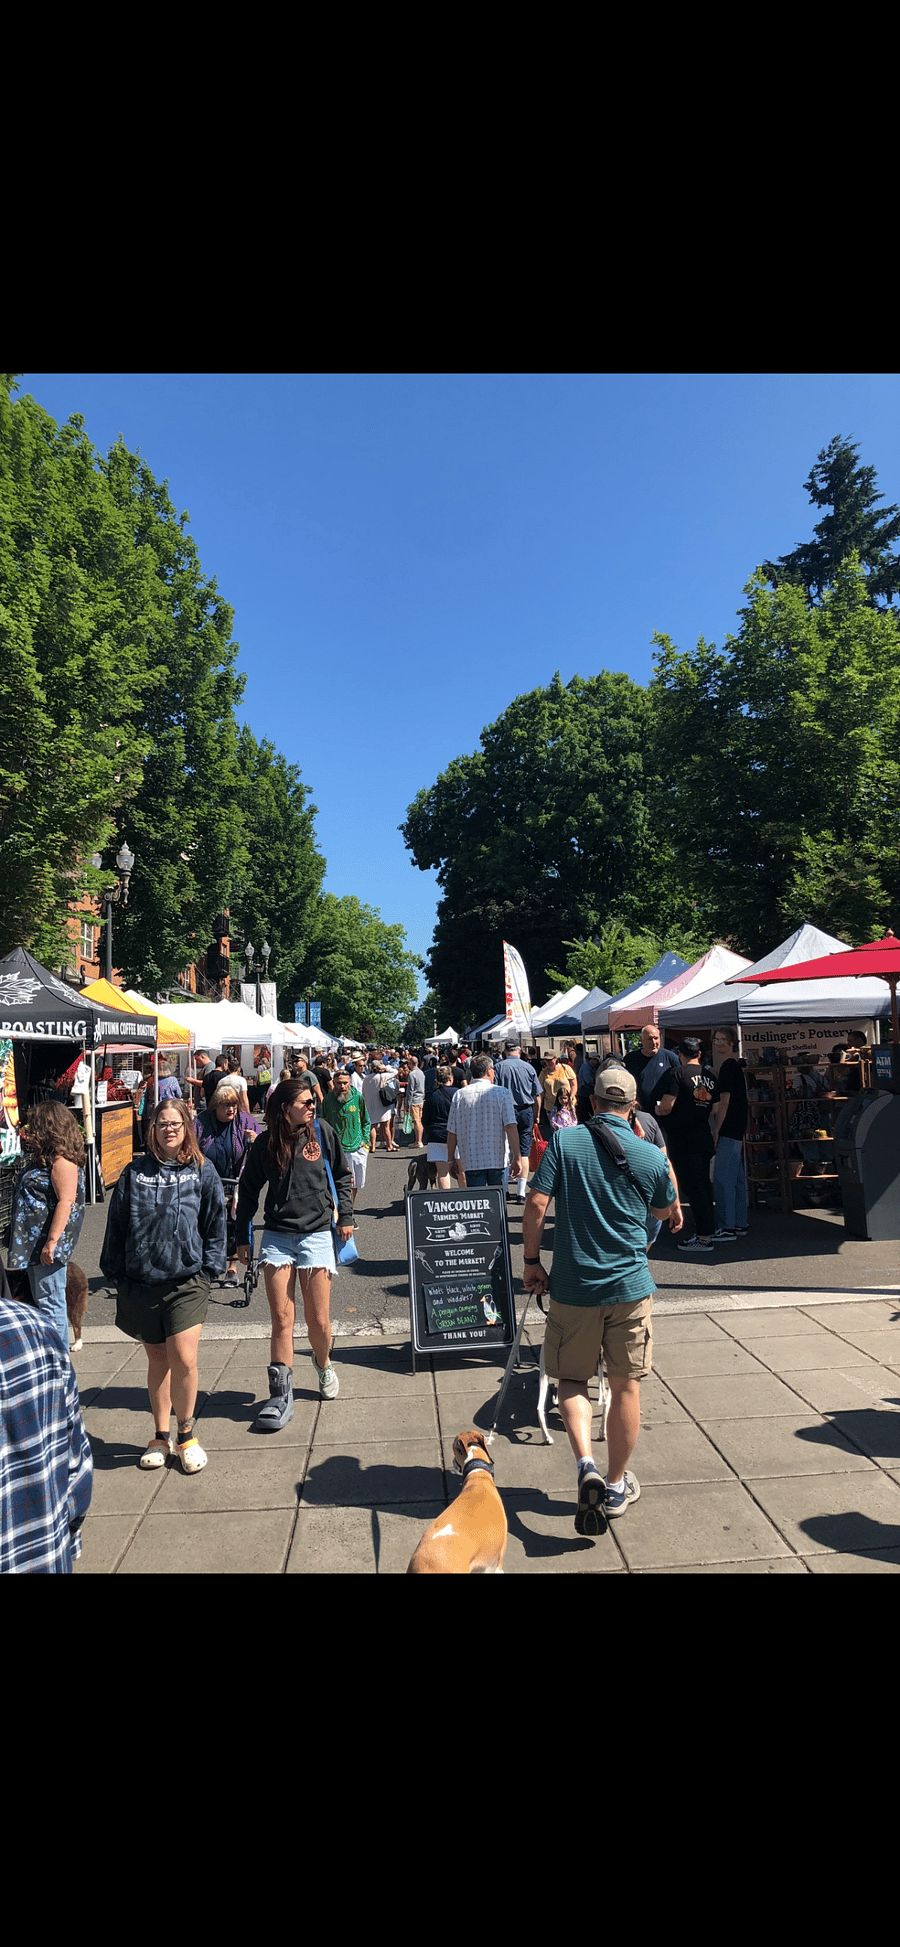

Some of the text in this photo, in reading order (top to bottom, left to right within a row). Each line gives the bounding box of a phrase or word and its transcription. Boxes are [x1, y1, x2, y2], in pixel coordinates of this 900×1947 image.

[1, 1020, 87, 1037] ROASTING
[94, 1017, 157, 1042] AUTUMN COFFEE ROASTING
[741, 1029, 806, 1043] udslinger's
[792, 1043, 817, 1051] Sheffield
[876, 1056, 892, 1066] ATM
[691, 1075, 715, 1090] VANS
[423, 1199, 491, 1213] VANCOUVER
[433, 1212, 484, 1221] FARMERS MARKET
[444, 1248, 475, 1257] WELCOME
[458, 1257, 485, 1266] MARKET!
[433, 1293, 473, 1306] and waddles?
[430, 1308, 437, 1318] A
[443, 1330, 486, 1339] THANK YOU!
